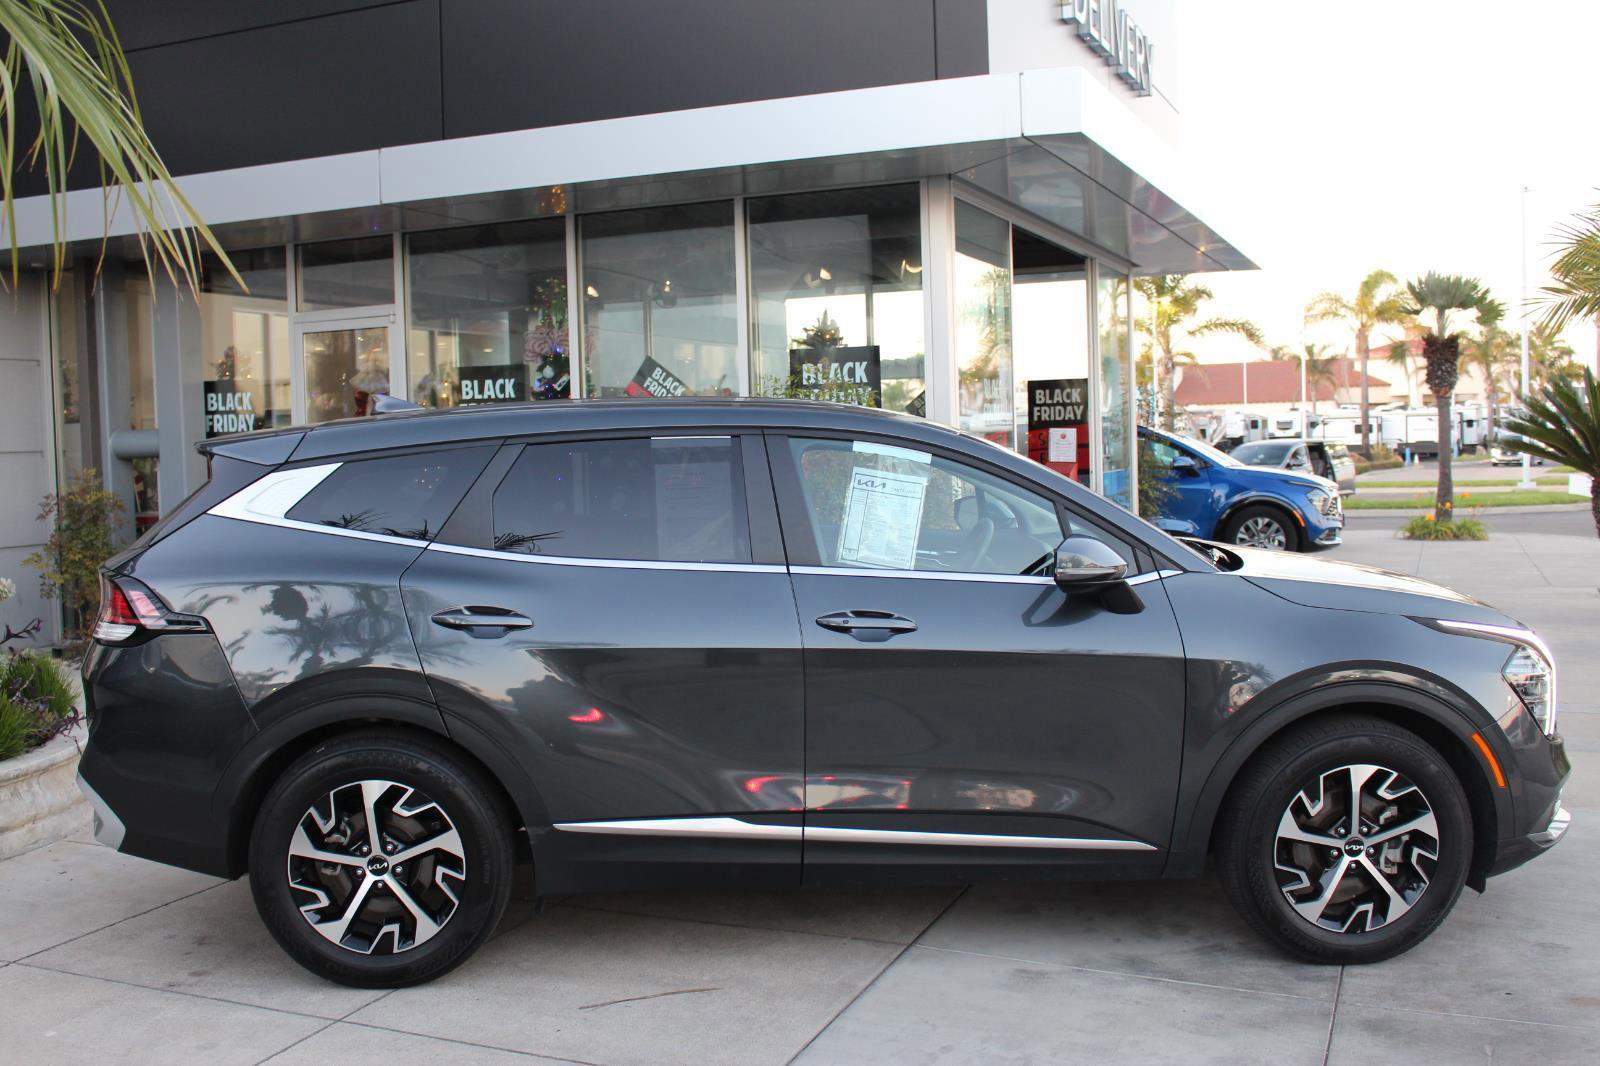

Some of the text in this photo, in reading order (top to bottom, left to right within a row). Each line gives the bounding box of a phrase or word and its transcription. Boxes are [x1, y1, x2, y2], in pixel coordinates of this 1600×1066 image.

[652, 367, 686, 397] BLACK
[803, 361, 868, 385] BLACK
[461, 378, 516, 400] BLACK
[1035, 388, 1081, 404] BLACK
[207, 392, 252, 411] BLACK
[1033, 405, 1084, 421] FRIDAY
[207, 414, 256, 433] FRIDAY
